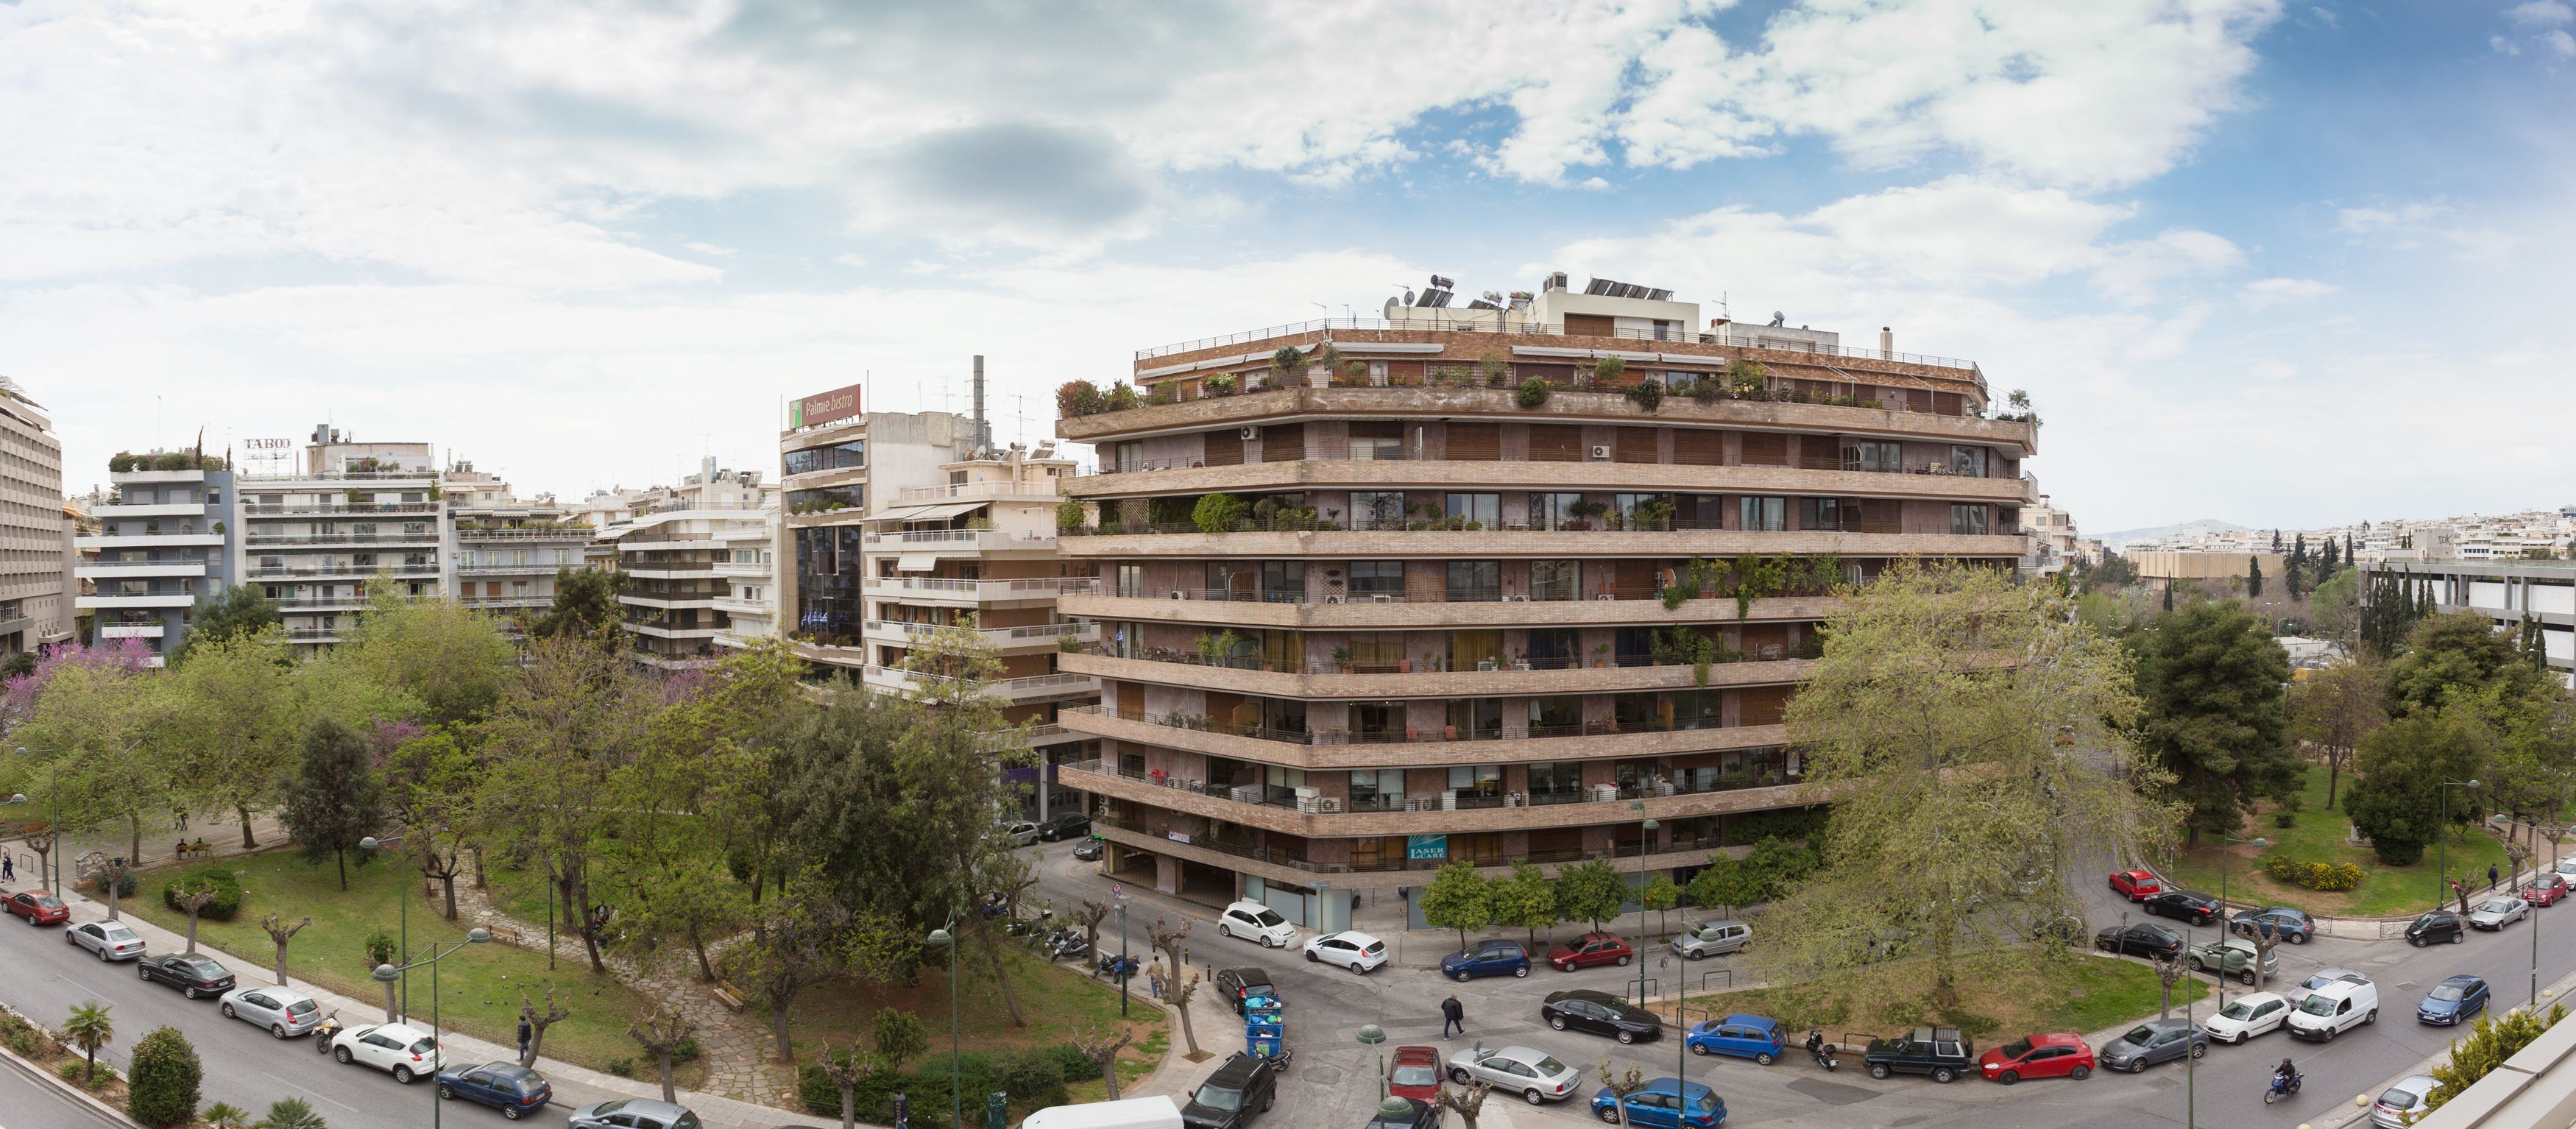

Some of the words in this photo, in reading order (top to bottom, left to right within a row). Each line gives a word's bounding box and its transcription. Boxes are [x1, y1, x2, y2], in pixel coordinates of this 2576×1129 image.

[806, 400, 829, 417] Palmie
[831, 394, 853, 411] bistro
[1411, 847, 1445, 859] LASER
